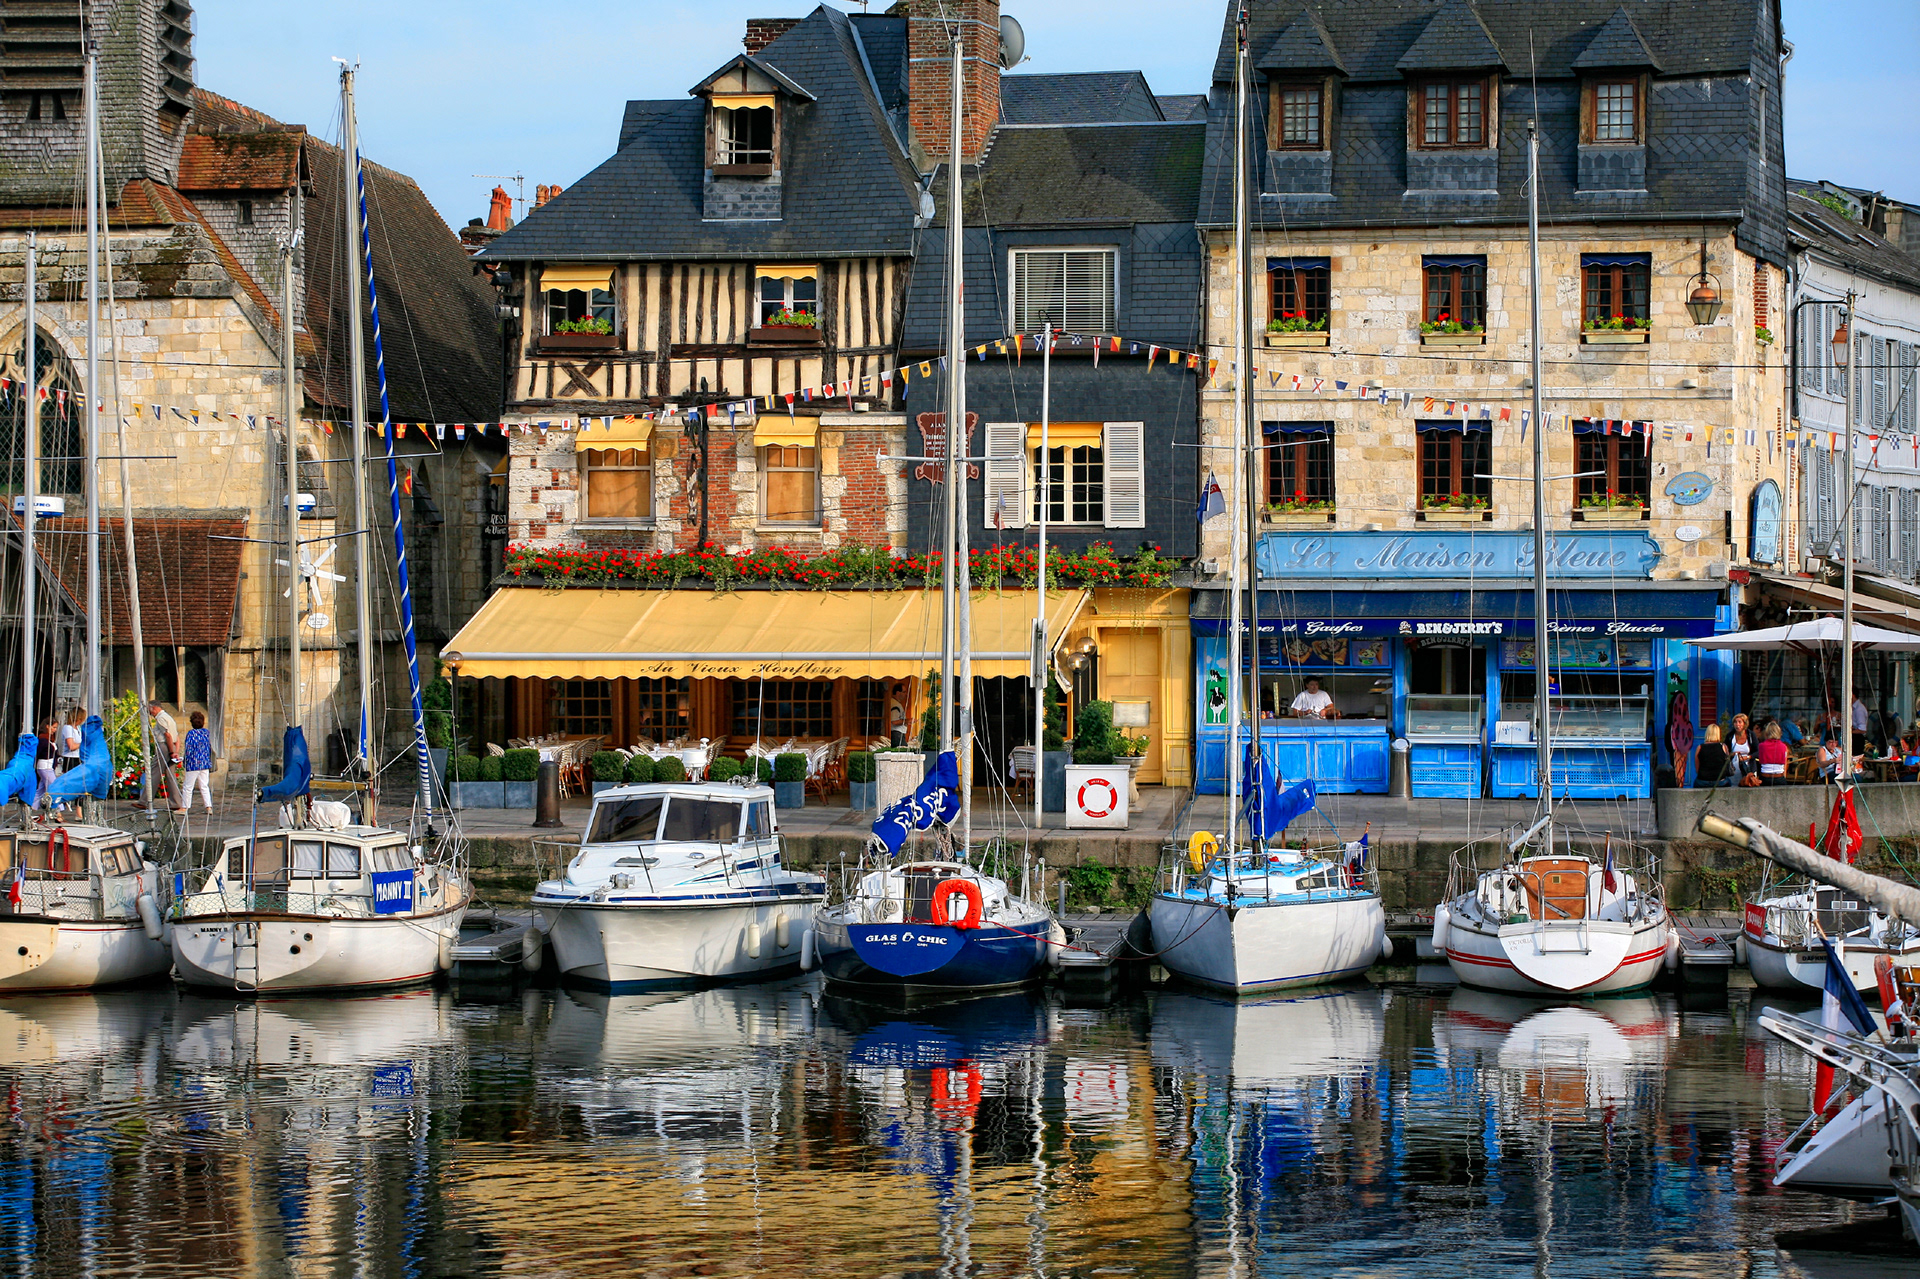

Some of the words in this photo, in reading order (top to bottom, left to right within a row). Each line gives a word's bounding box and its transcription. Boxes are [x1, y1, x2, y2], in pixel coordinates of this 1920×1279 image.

[1284, 536, 1341, 569] La
[1355, 536, 1495, 569] Maison
[1514, 537, 1627, 568] Bleue
[1282, 623, 1298, 633] et
[1304, 621, 1364, 635] Gaufres
[1416, 621, 1503, 635] BEN&JERRY'S
[1546, 622, 1596, 633] Crèmes
[1604, 622, 1665, 635] Glacées
[640, 661, 678, 673] Au
[688, 661, 742, 673] Vieux
[752, 661, 846, 675] Honfleur
[376, 881, 403, 902] MANNY
[403, 880, 412, 899] II
[865, 934, 898, 942] GLAS
[918, 935, 948, 945] CHIC
